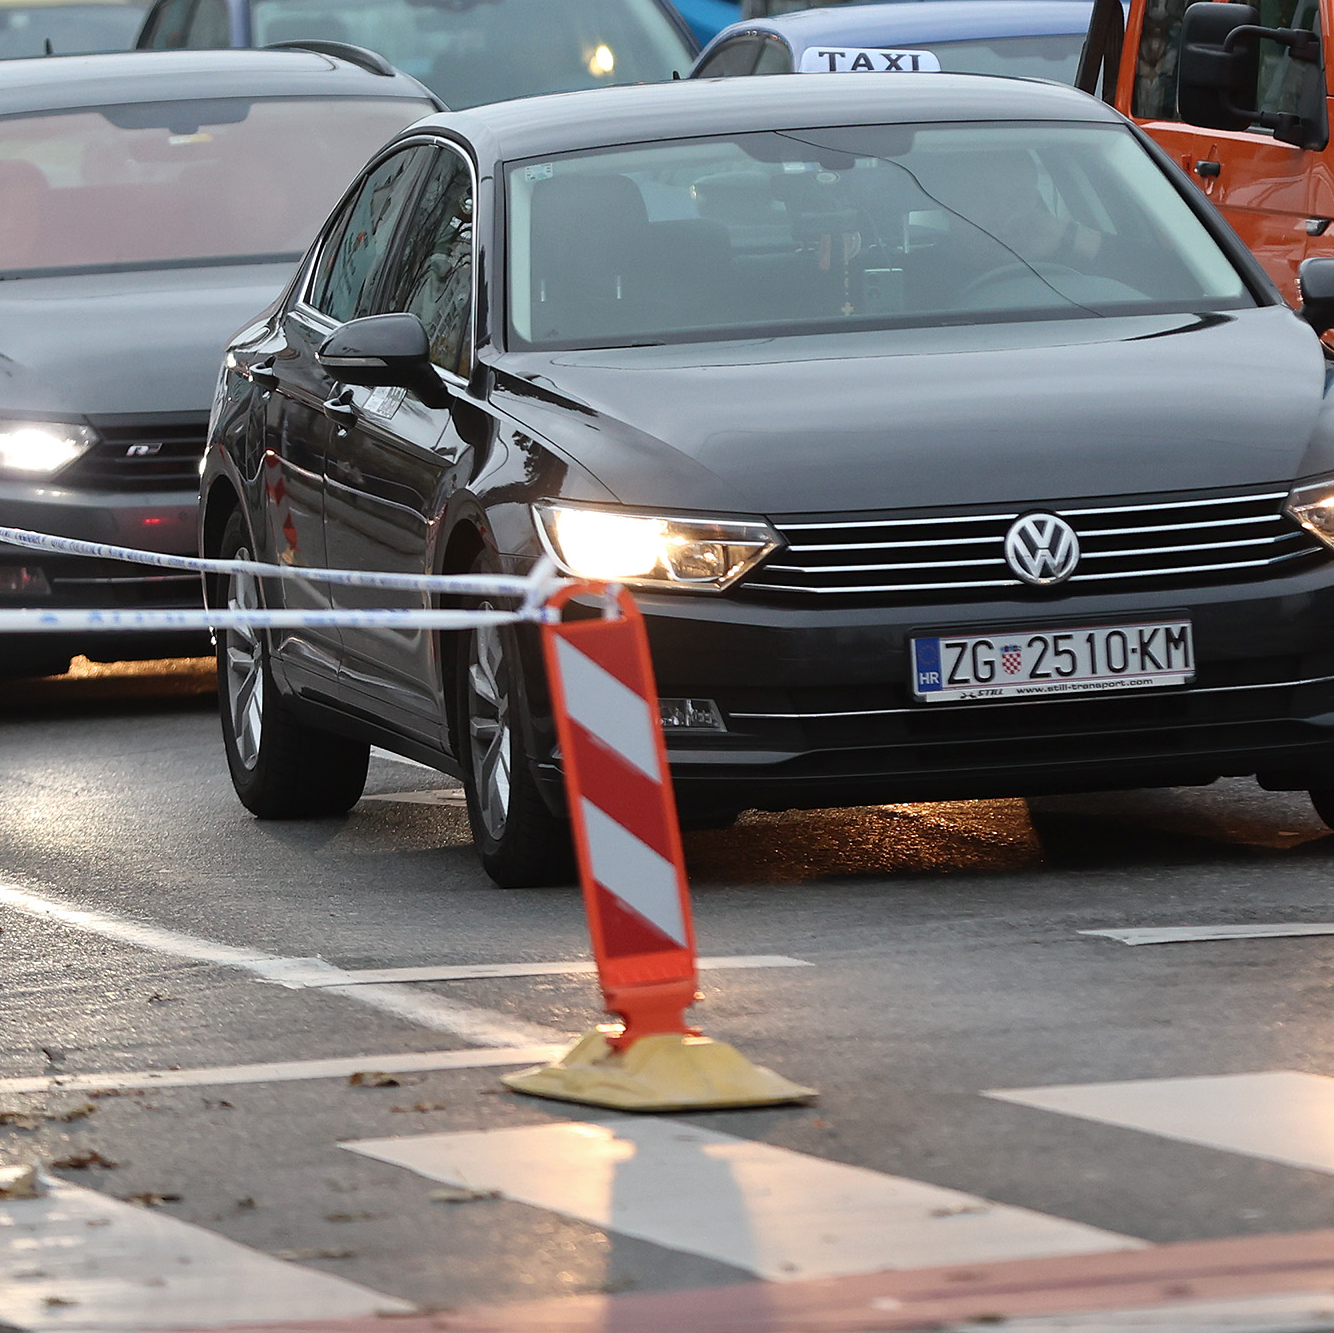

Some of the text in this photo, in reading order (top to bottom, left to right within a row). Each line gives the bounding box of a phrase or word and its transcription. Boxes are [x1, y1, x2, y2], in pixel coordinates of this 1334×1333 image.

[818, 51, 921, 72] TAXI
[944, 625, 1192, 686] ZG 2510-KM
[919, 671, 940, 686] HR
[1016, 678, 1154, 694] www.still-transport.com
